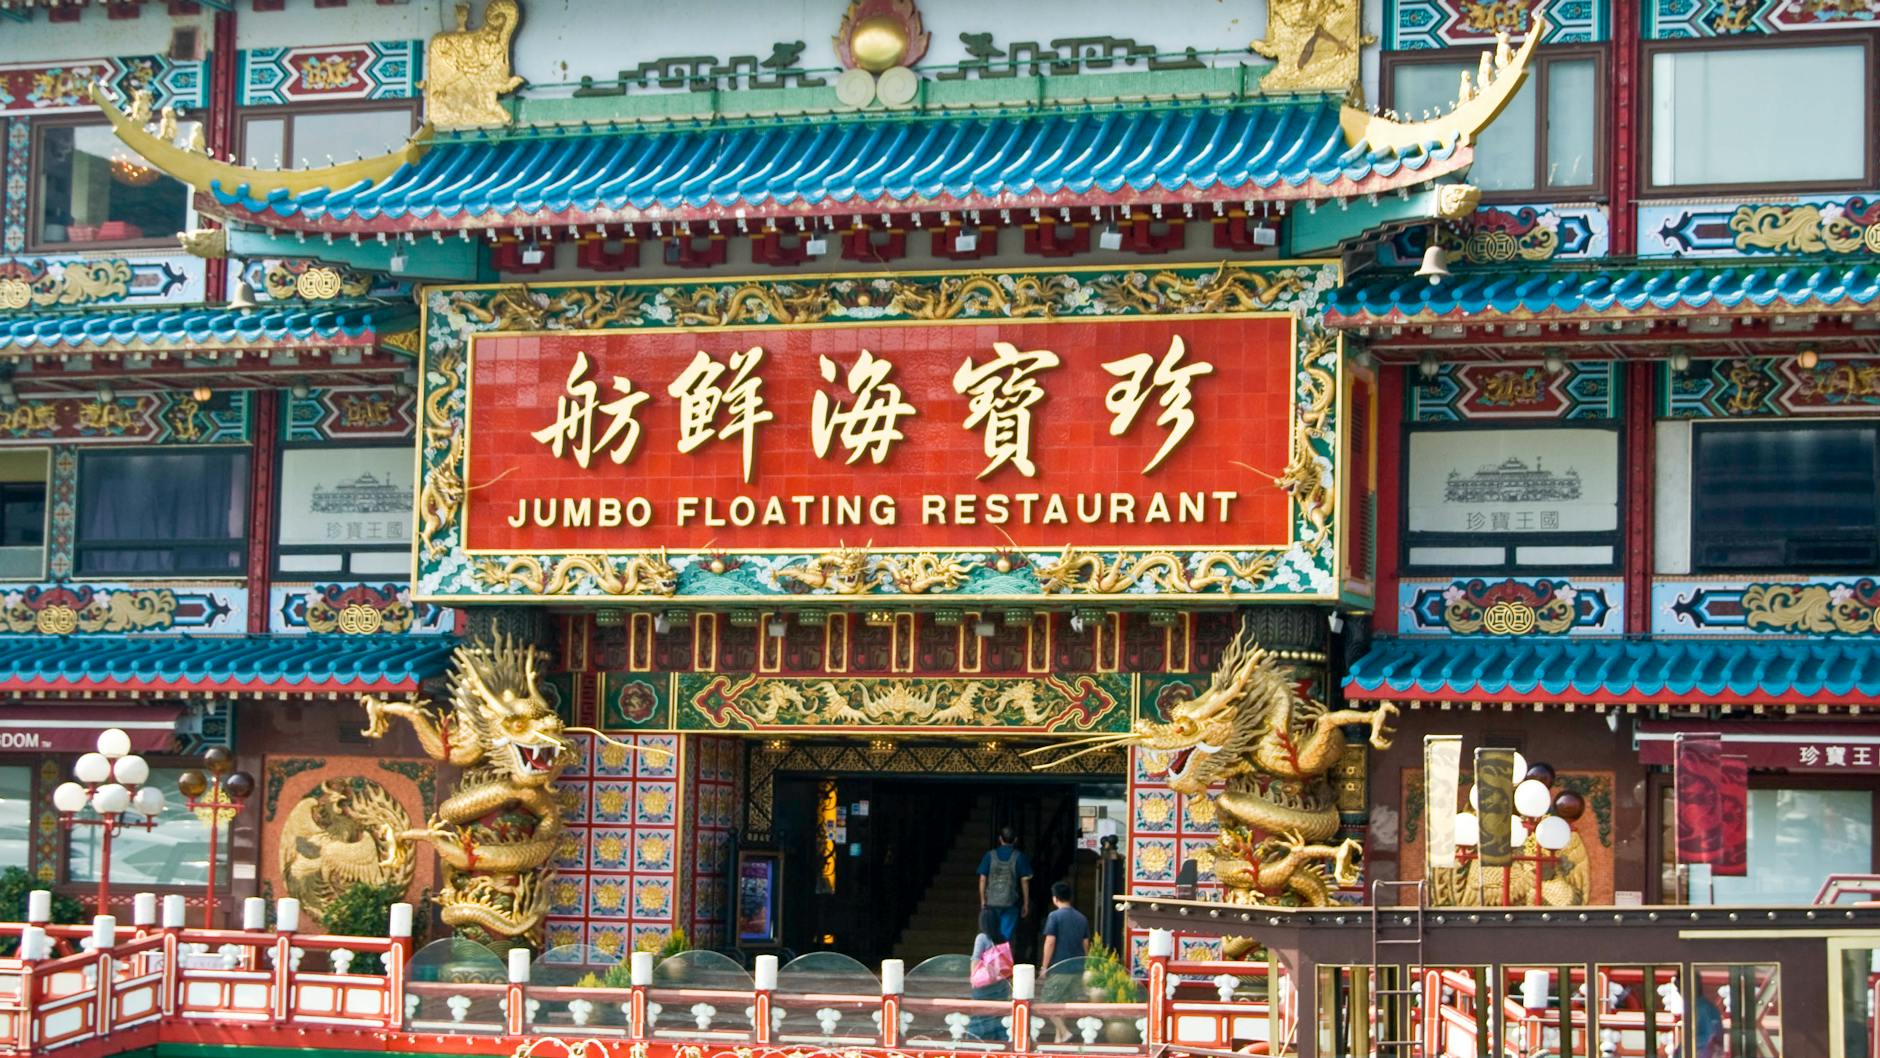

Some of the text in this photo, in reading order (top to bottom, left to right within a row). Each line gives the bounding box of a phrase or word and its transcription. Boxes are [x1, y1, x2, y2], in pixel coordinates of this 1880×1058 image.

[507, 491, 1238, 529] JUMBO FLOATING RESTAURANT
[1466, 510, 1559, 530] 珍寶王國
[0, 732, 39, 748] DOM
[1799, 745, 1880, 767] 珍寶王
